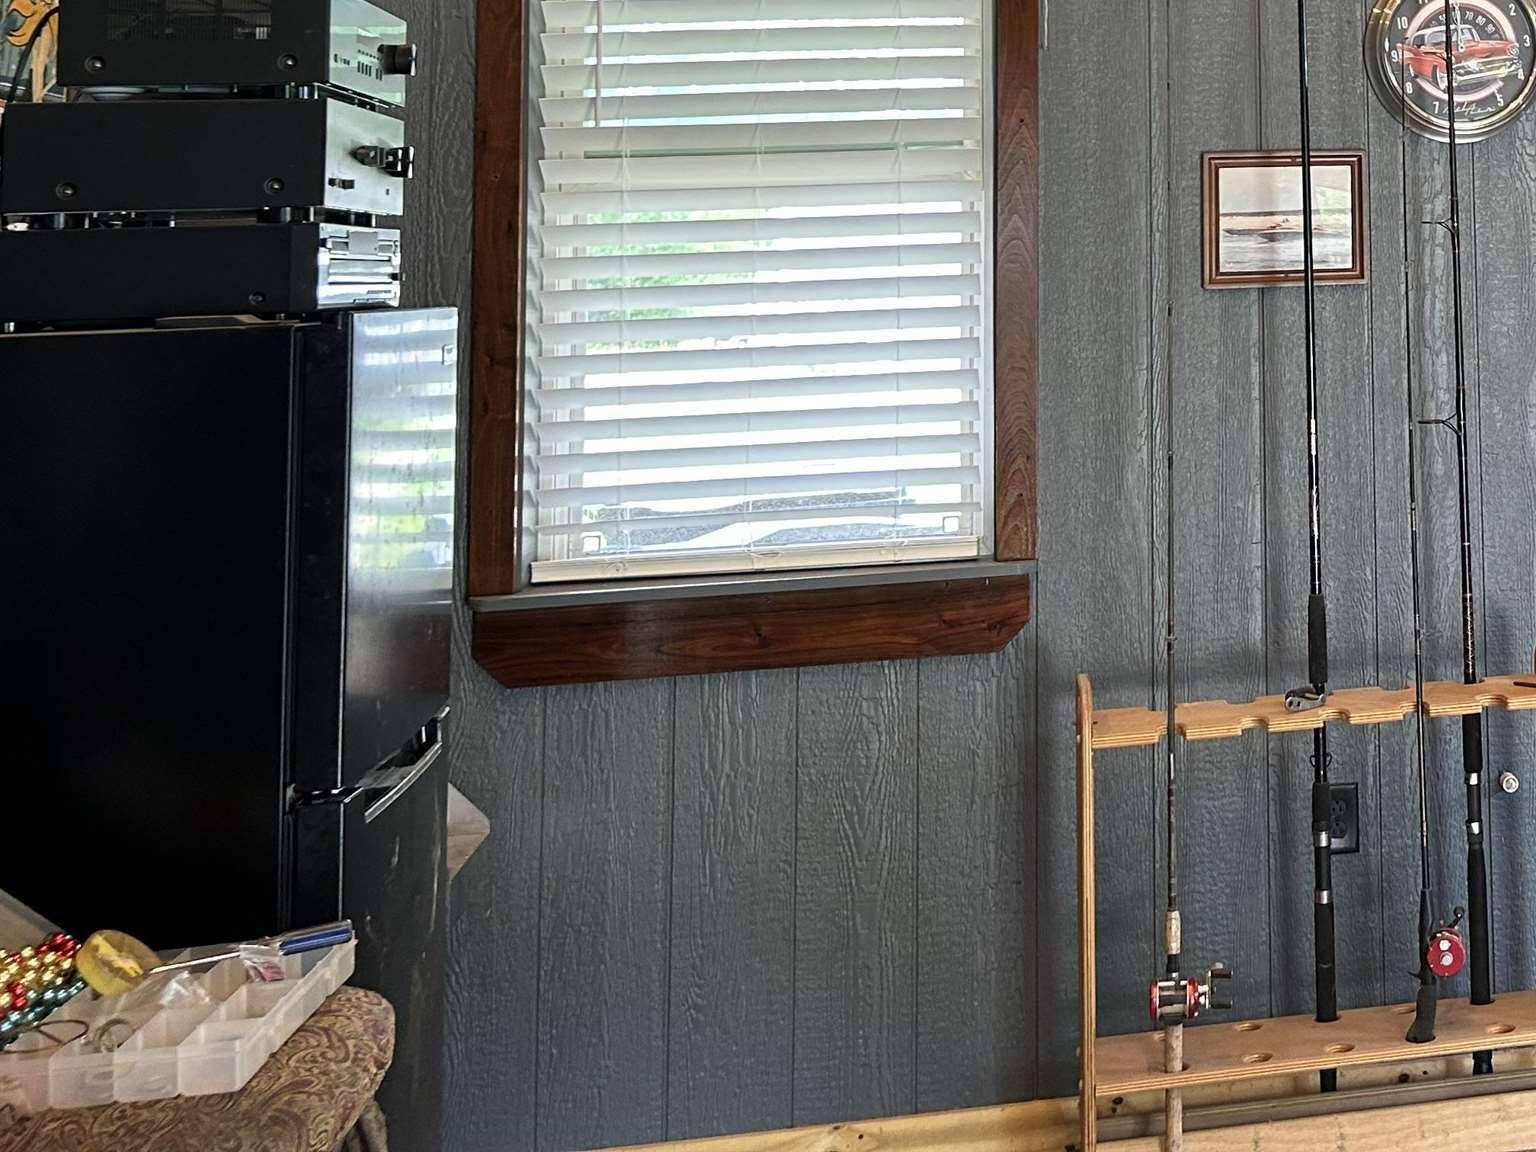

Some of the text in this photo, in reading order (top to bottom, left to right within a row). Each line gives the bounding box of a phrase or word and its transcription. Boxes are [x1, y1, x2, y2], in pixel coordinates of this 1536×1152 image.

[1509, 3, 1516, 17] 2
[1397, 16, 1408, 29] 10
[1523, 34, 1530, 47] 3
[1391, 50, 1398, 62] 9
[1406, 82, 1413, 94] 8
[1433, 102, 1439, 113] 7
